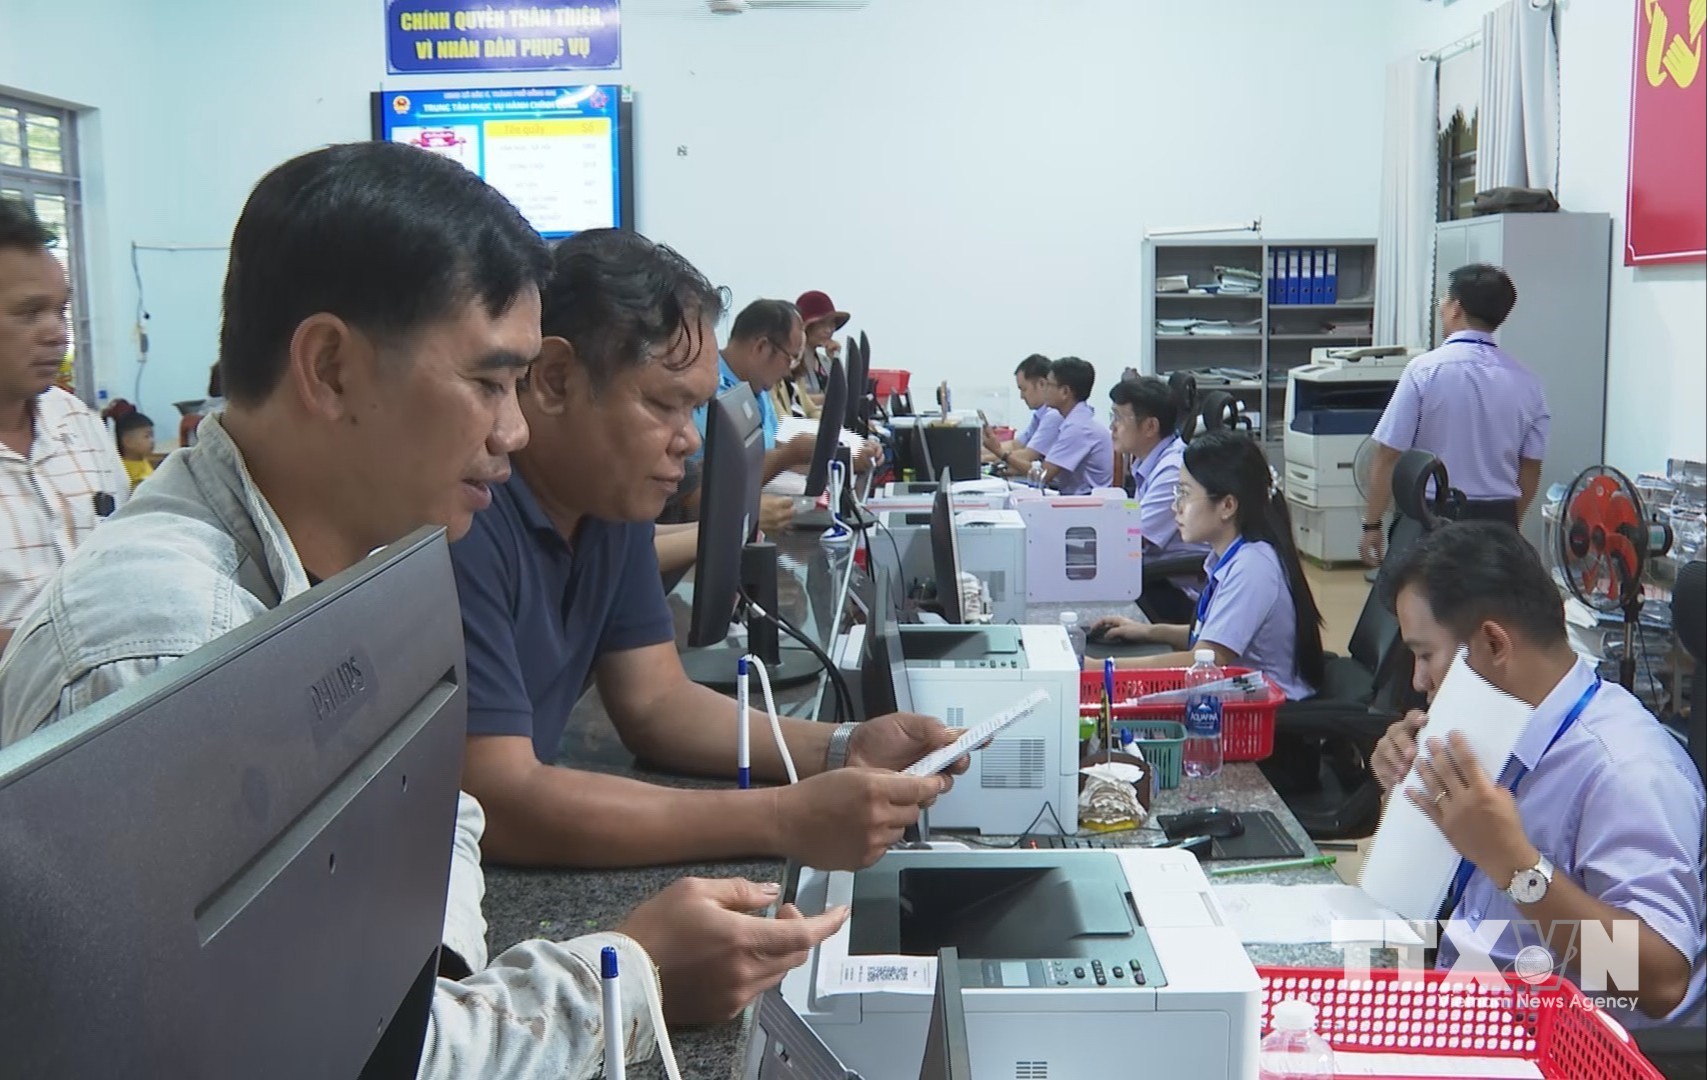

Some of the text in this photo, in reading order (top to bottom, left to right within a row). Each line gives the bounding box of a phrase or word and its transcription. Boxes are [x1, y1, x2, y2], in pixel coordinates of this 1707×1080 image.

[401, 10, 450, 31] CHÍNH
[454, 5, 505, 31] QUYỀN
[508, 7, 551, 29] THÂN
[415, 36, 590, 60] VÌ NHÂN DÂN PHỤC VỤ
[423, 103, 450, 112] TRUNG
[452, 102, 470, 111] TÂM
[309, 656, 366, 721] PHILIPS
